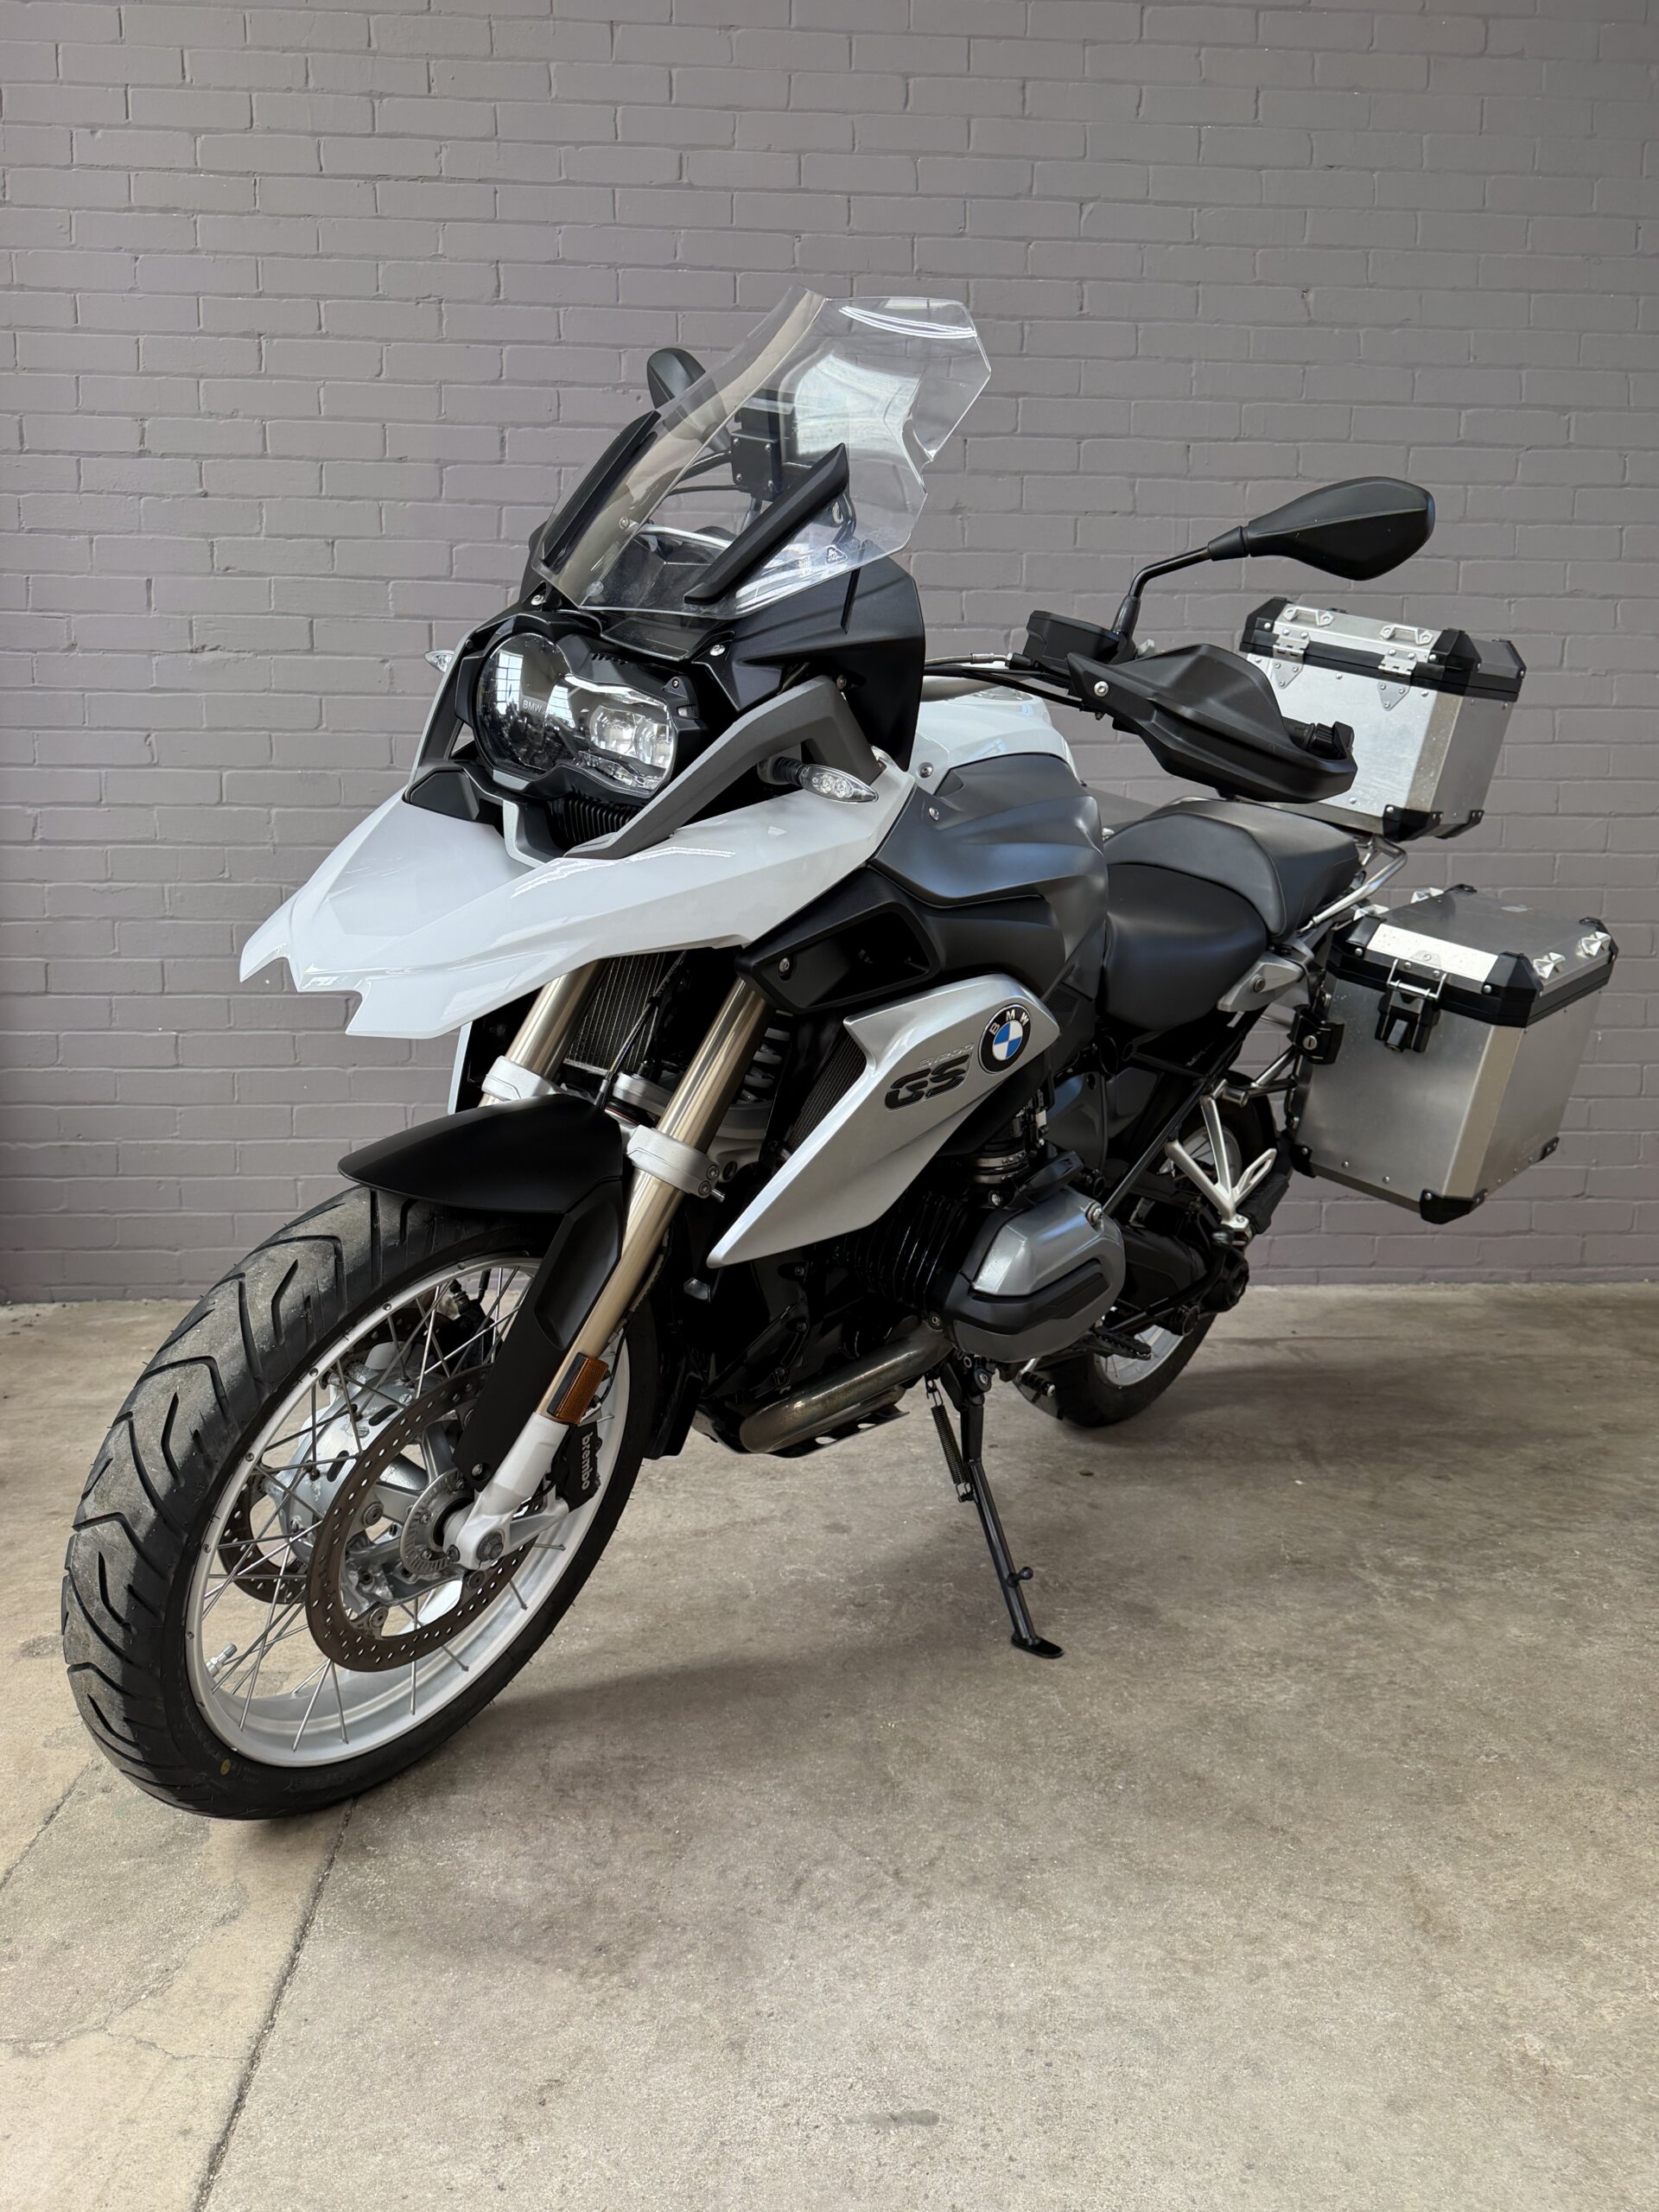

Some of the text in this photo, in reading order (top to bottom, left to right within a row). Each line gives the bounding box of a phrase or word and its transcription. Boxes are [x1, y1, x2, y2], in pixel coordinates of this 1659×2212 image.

[523, 699, 543, 713] BMW
[988, 1008, 1029, 1035] BMW
[884, 1053, 970, 1109] GS
[582, 1431, 594, 1491] brembo
